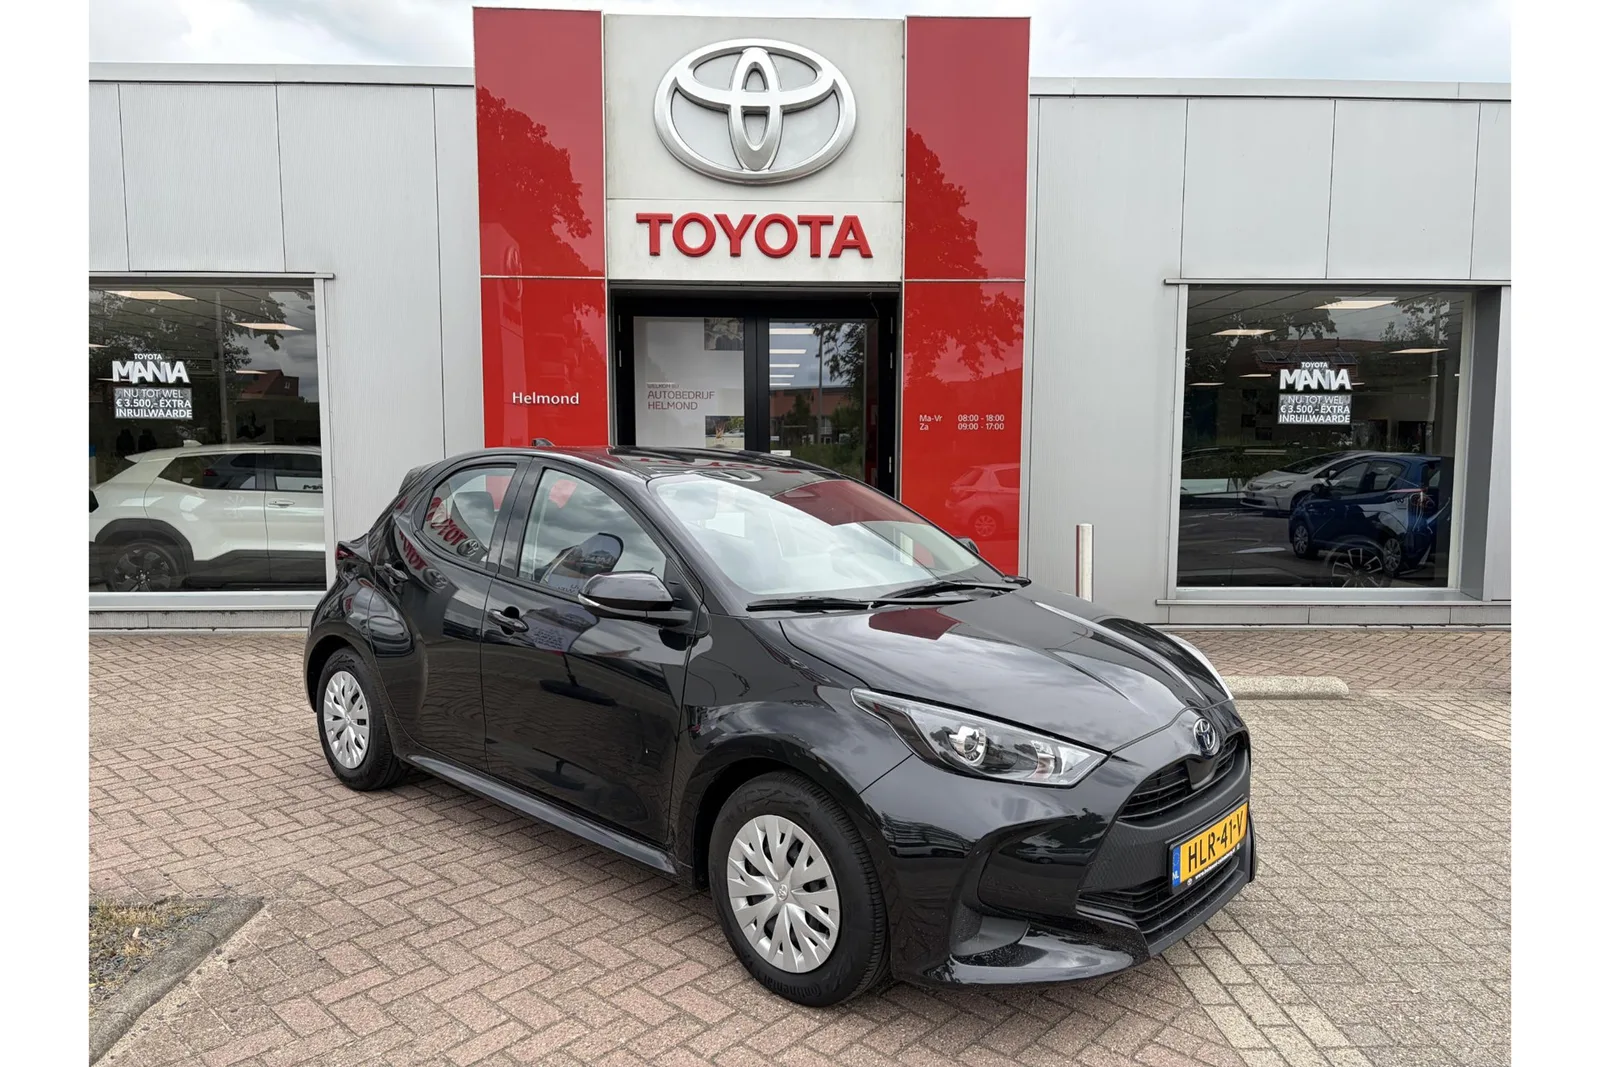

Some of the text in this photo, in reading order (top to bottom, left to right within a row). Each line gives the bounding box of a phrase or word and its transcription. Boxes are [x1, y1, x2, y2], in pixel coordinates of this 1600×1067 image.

[636, 212, 873, 258] TOYOTA
[112, 360, 191, 384] MANIA
[1279, 369, 1352, 391] MANIA
[123, 389, 184, 399] NU TOT WEL
[512, 391, 579, 405] Helmond
[647, 390, 715, 400] AUTOBEDRIJF
[1288, 395, 1344, 405] NU TOT WEL
[647, 401, 698, 410] HELMOND
[116, 408, 193, 418] INRUILWAARDE
[919, 414, 942, 422] Ma-Vr
[957, 414, 979, 422] 08:00
[985, 414, 1005, 422] 18:00
[1279, 414, 1351, 423] INRUILWAARDE
[919, 423, 929, 431] Za
[957, 423, 979, 431] 09:00
[1188, 810, 1244, 873] HLR-41-V
